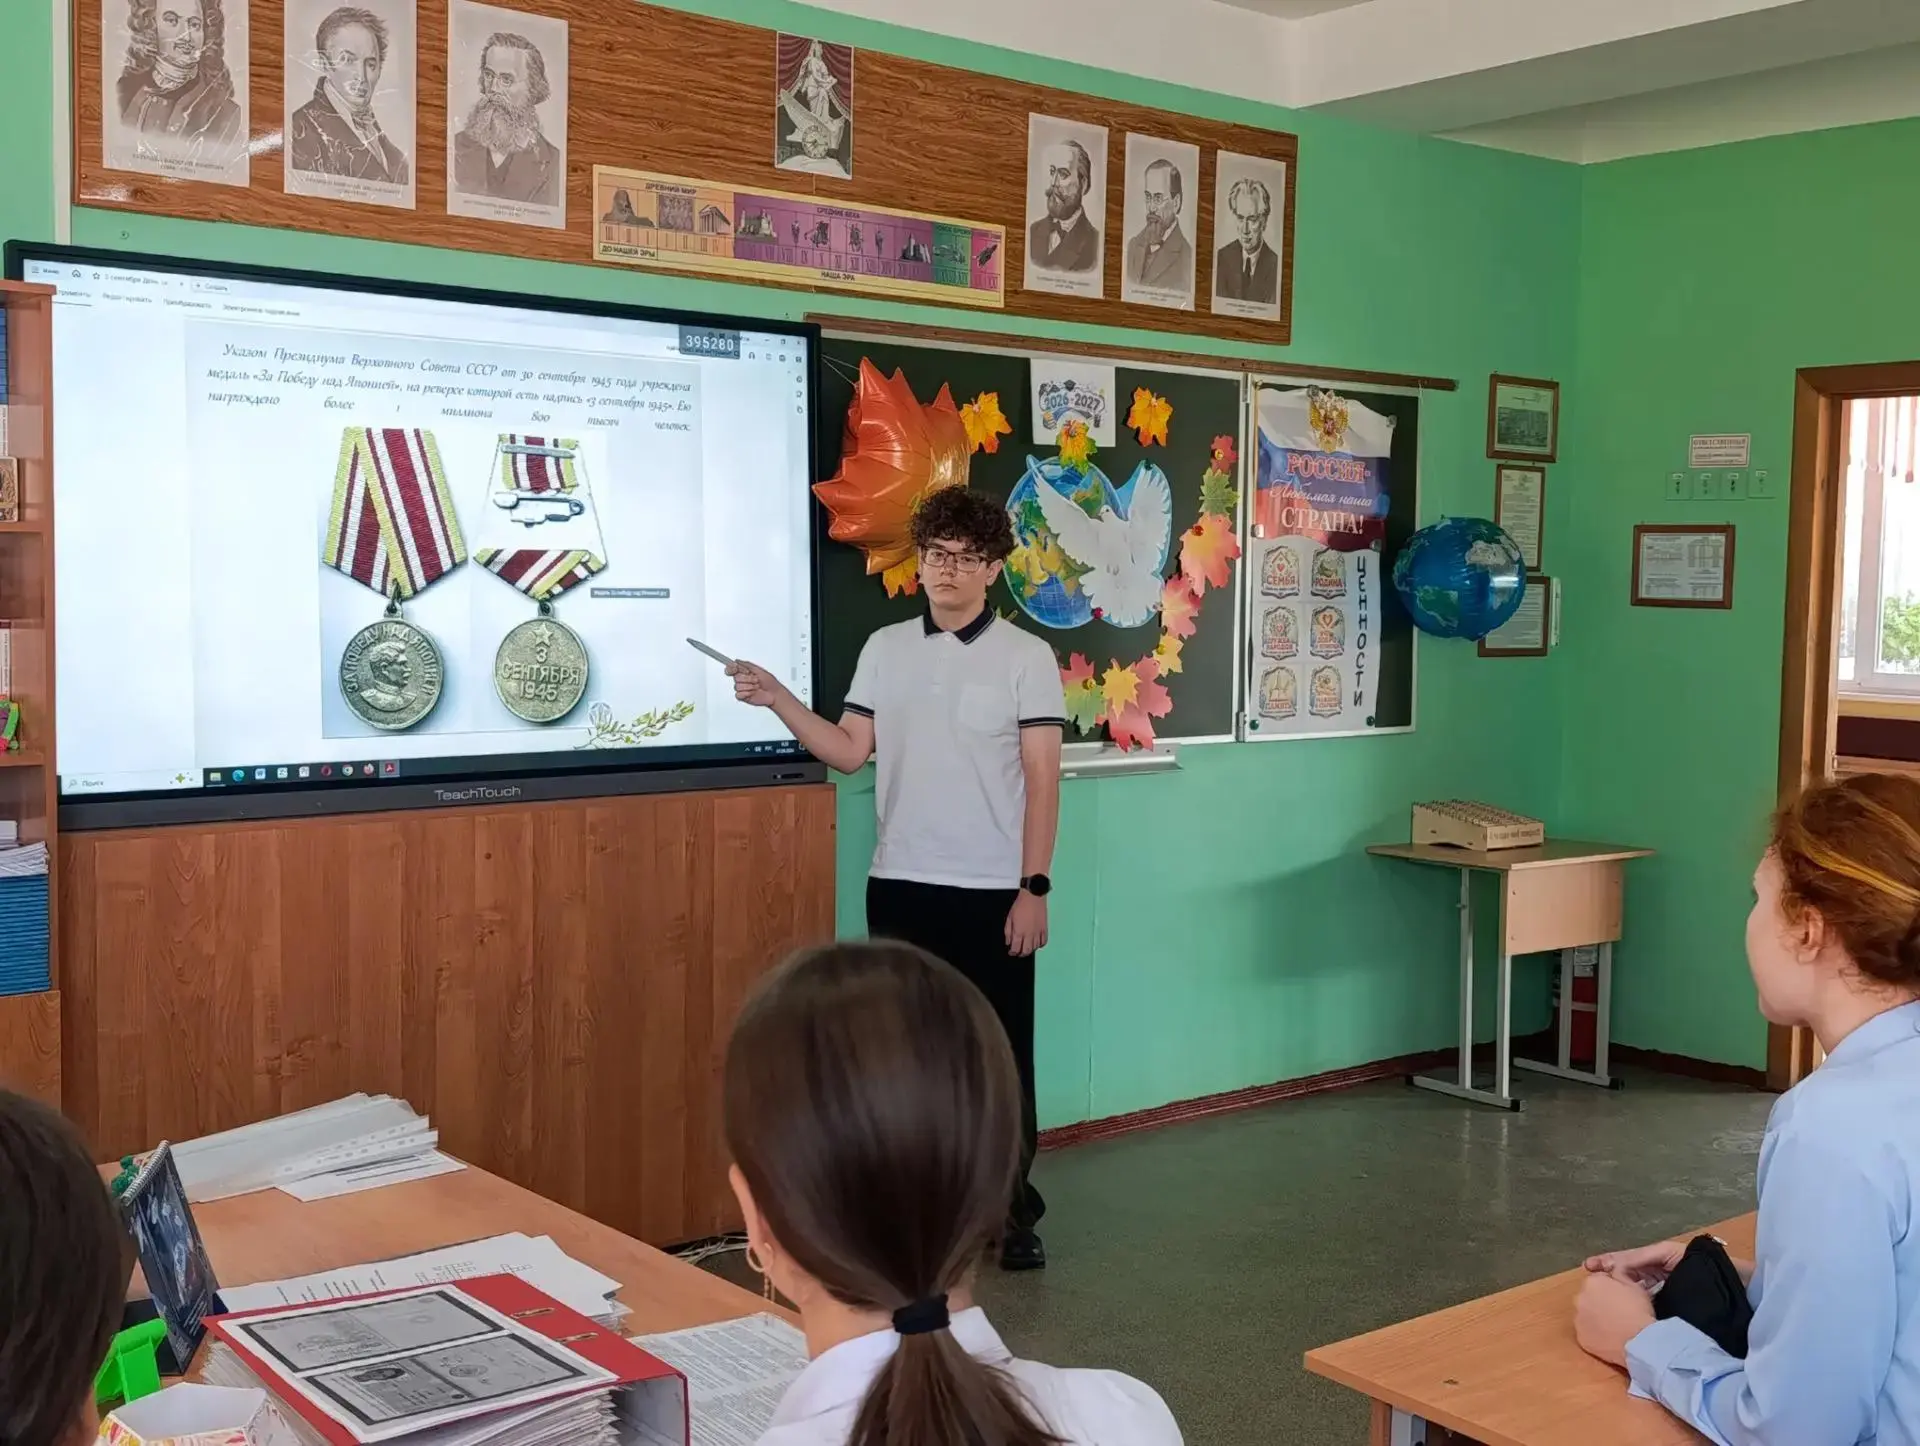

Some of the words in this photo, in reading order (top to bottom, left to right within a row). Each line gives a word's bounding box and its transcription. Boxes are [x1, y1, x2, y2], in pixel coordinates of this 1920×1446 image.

[686, 335, 734, 351] 395280
[222, 343, 267, 358] Указом
[274, 347, 346, 367] Президиума
[351, 353, 415, 371] Верховного
[420, 358, 461, 374] Совета
[466, 363, 498, 376] СССР
[501, 369, 517, 378] от
[520, 371, 534, 381] 30
[537, 371, 586, 386] сентября
[591, 376, 612, 389] 1945
[616, 379, 637, 389] года
[640, 380, 691, 392] учреждена
[206, 368, 250, 382] медаль
[252, 368, 273, 382] «За
[277, 370, 319, 389] Победу
[322, 376, 343, 388] над
[406, 383, 420, 392] на
[422, 384, 464, 398] реверсе
[467, 388, 512, 400] которой
[516, 391, 539, 400] есть
[543, 393, 582, 405] надпись
[598, 395, 645, 411] сентября
[677, 400, 692, 411] Ею
[207, 392, 281, 406] награждено
[323, 395, 355, 410] более
[441, 407, 493, 418] миллиона
[531, 410, 551, 422] 800
[586, 416, 620, 426] тысяч
[1269, 479, 1337, 503] Любимая
[1281, 506, 1365, 535] СТРАНА!
[1266, 575, 1296, 586] СЕМЬЯ
[1315, 577, 1343, 588] РОДИНА
[1353, 555, 1368, 707] ЦЕННОСТИ
[535, 647, 548, 662] 3
[502, 662, 580, 686] СЕНТЯБРЯ
[519, 682, 557, 700] 1945
[434, 785, 521, 800] TeachTouch
